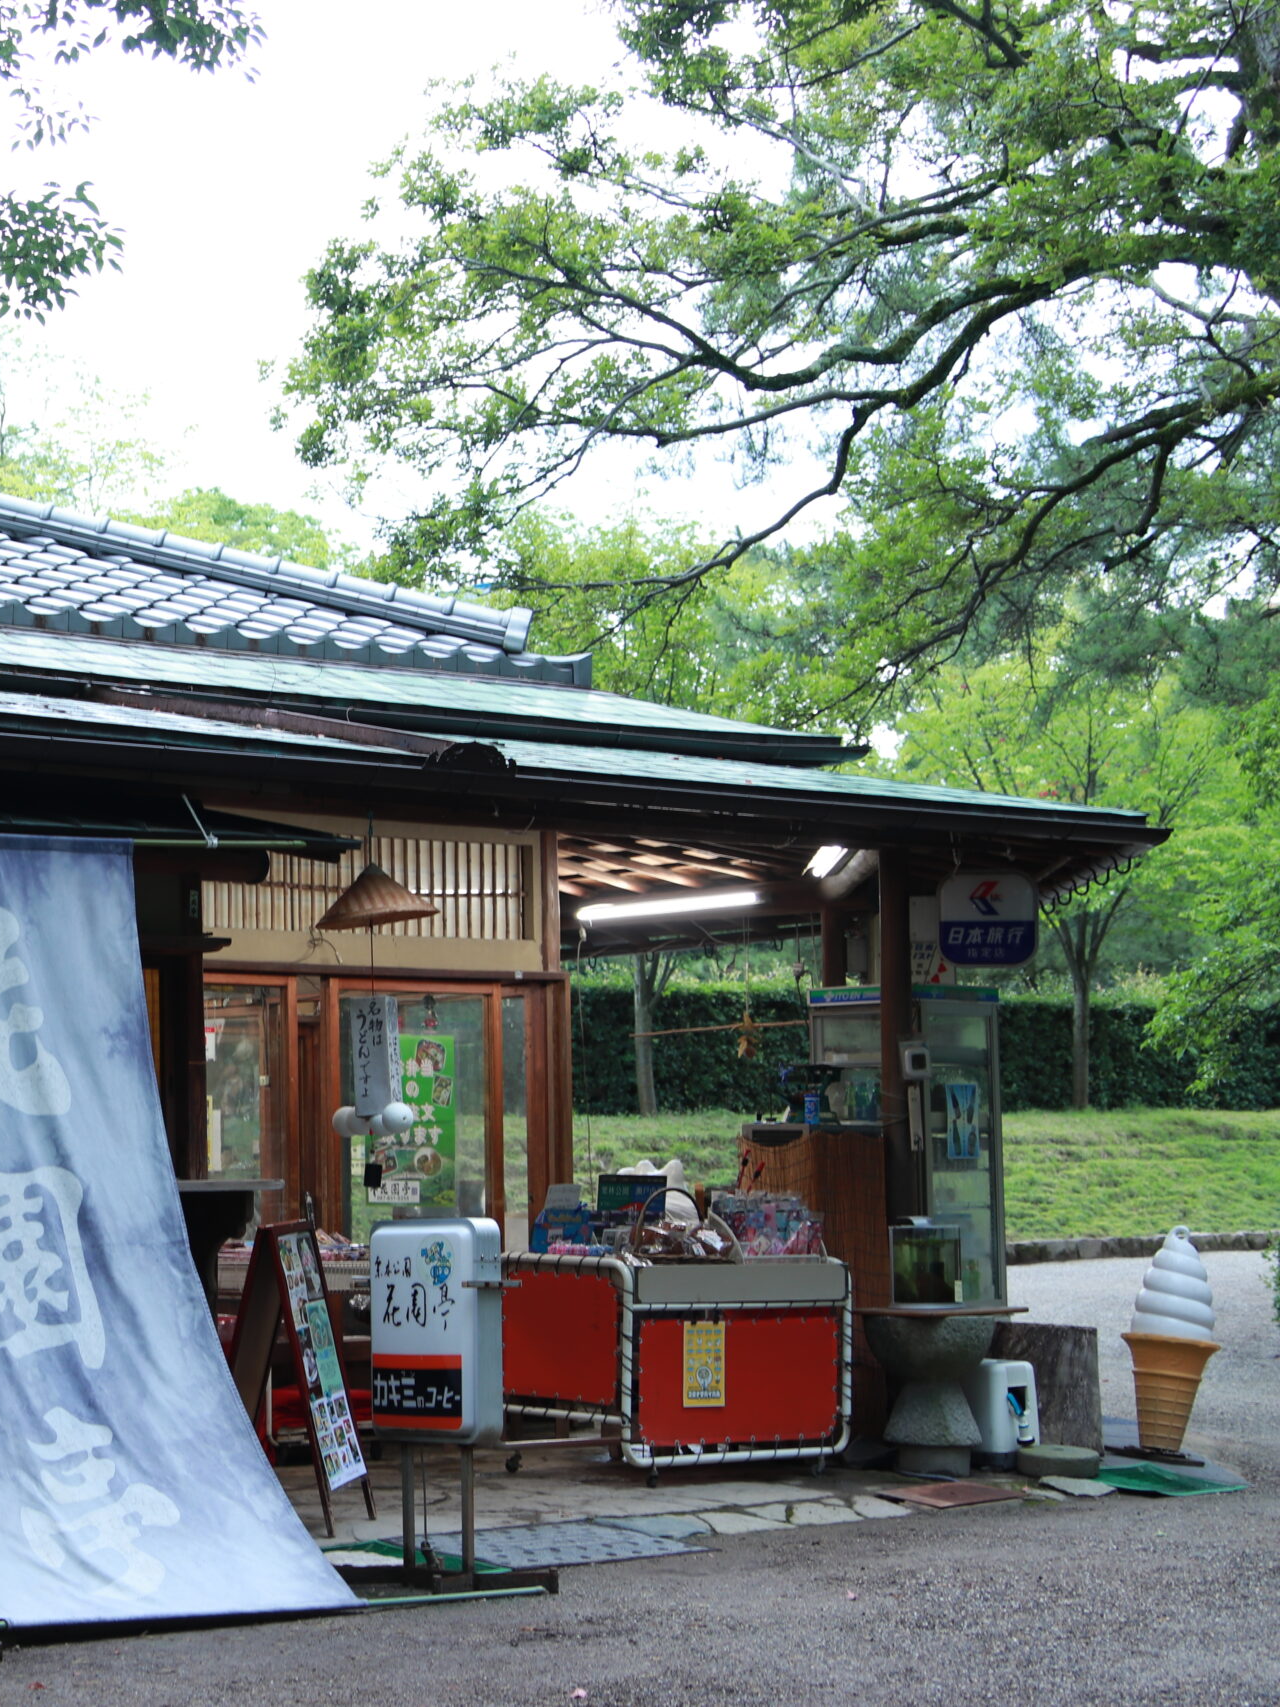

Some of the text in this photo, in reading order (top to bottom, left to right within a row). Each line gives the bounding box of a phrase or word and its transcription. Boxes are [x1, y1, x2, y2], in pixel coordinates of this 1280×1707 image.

[948, 926, 1024, 945] 日本旅行
[367, 999, 383, 1046] 名物は
[356, 1009, 371, 1098] うどんですよ
[383, 1282, 456, 1331] 花園亭
